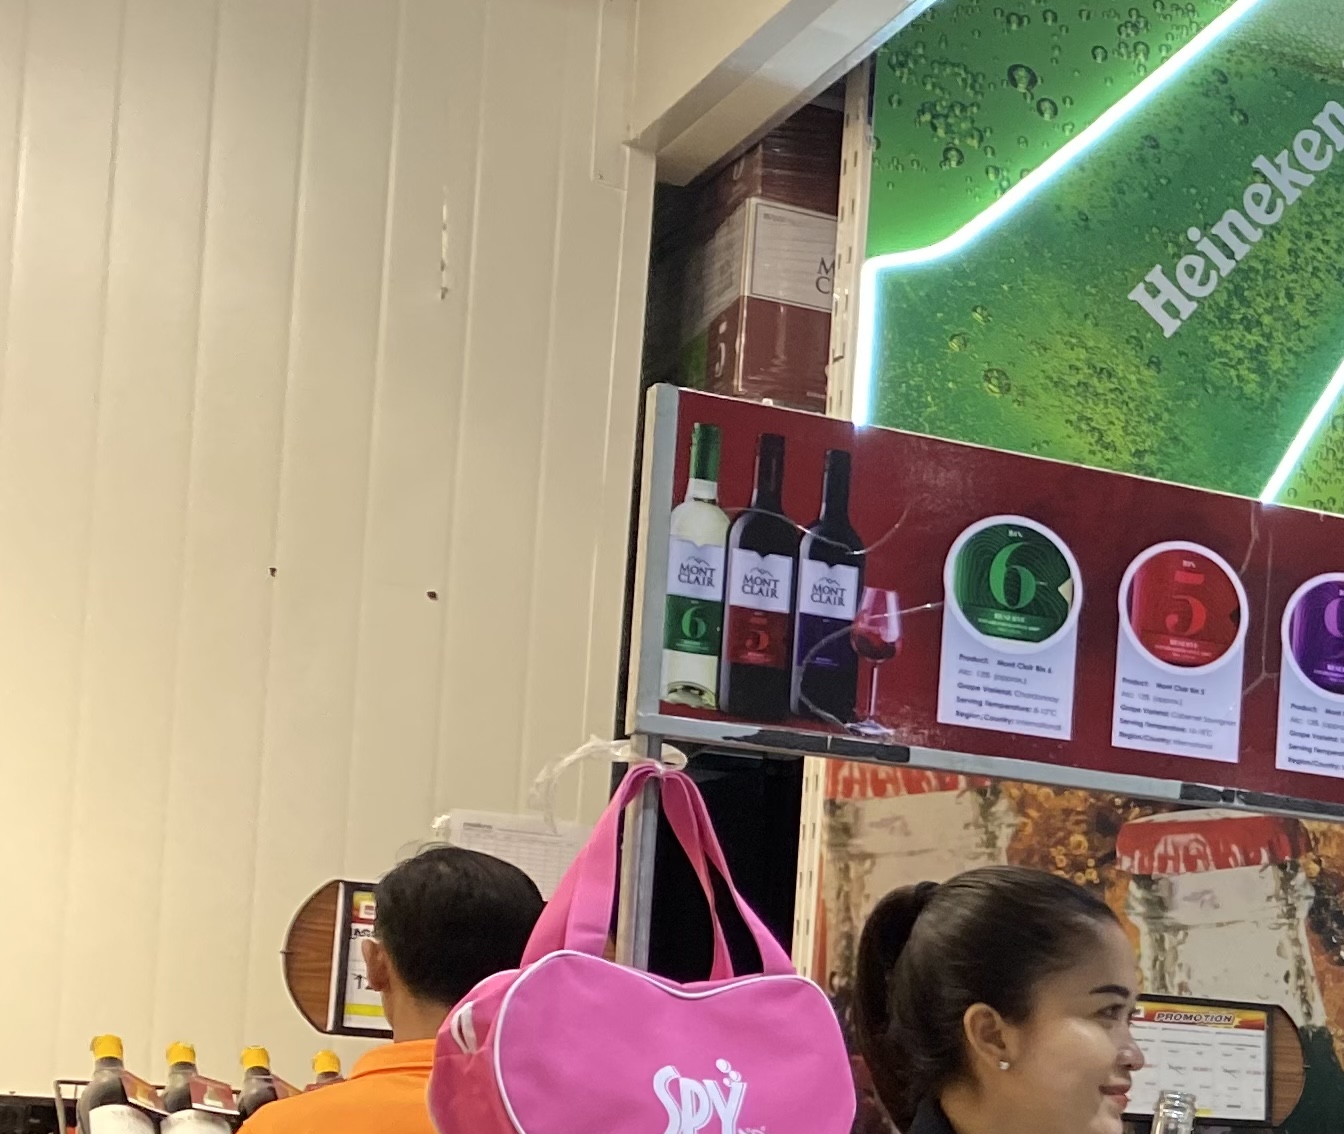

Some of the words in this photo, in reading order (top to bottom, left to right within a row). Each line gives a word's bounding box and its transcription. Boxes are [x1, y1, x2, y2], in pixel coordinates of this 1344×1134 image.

[679, 562, 716, 577] MONT
[989, 541, 1036, 610] 6
[678, 573, 715, 587] CLAIR
[743, 574, 780, 588] MONT
[742, 584, 779, 599] CLAIR
[812, 584, 847, 598] MONT
[810, 593, 846, 607] CLAIR
[1165, 570, 1206, 637] 5
[681, 607, 707, 639] 6
[1155, 1012, 1233, 1023] PROMOTION
